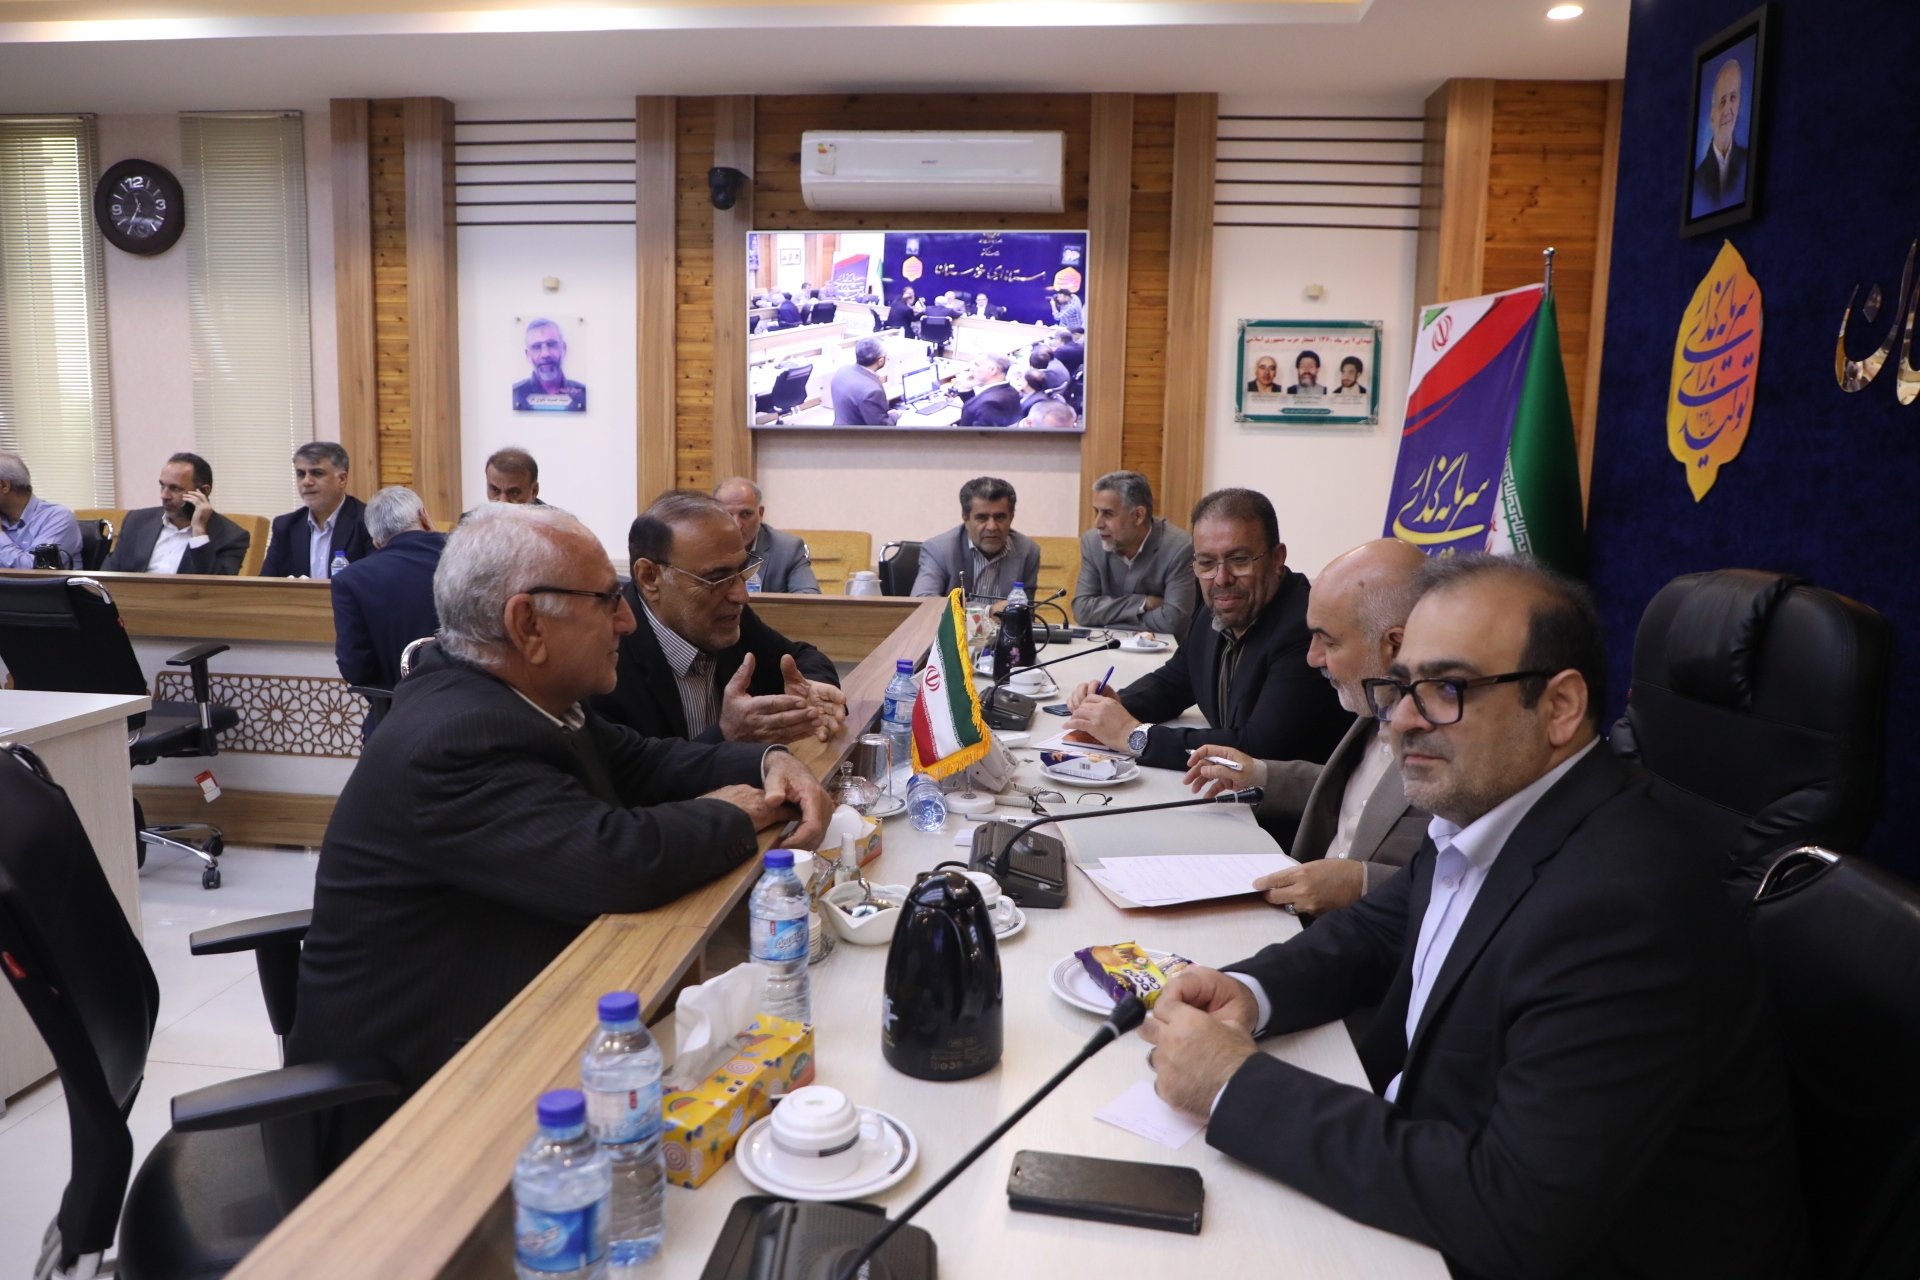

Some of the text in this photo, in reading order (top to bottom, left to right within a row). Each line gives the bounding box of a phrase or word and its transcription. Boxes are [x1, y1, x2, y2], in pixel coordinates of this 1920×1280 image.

[125, 176, 144, 188] 12
[112, 204, 123, 216] 9
[155, 199, 167, 211] 3
